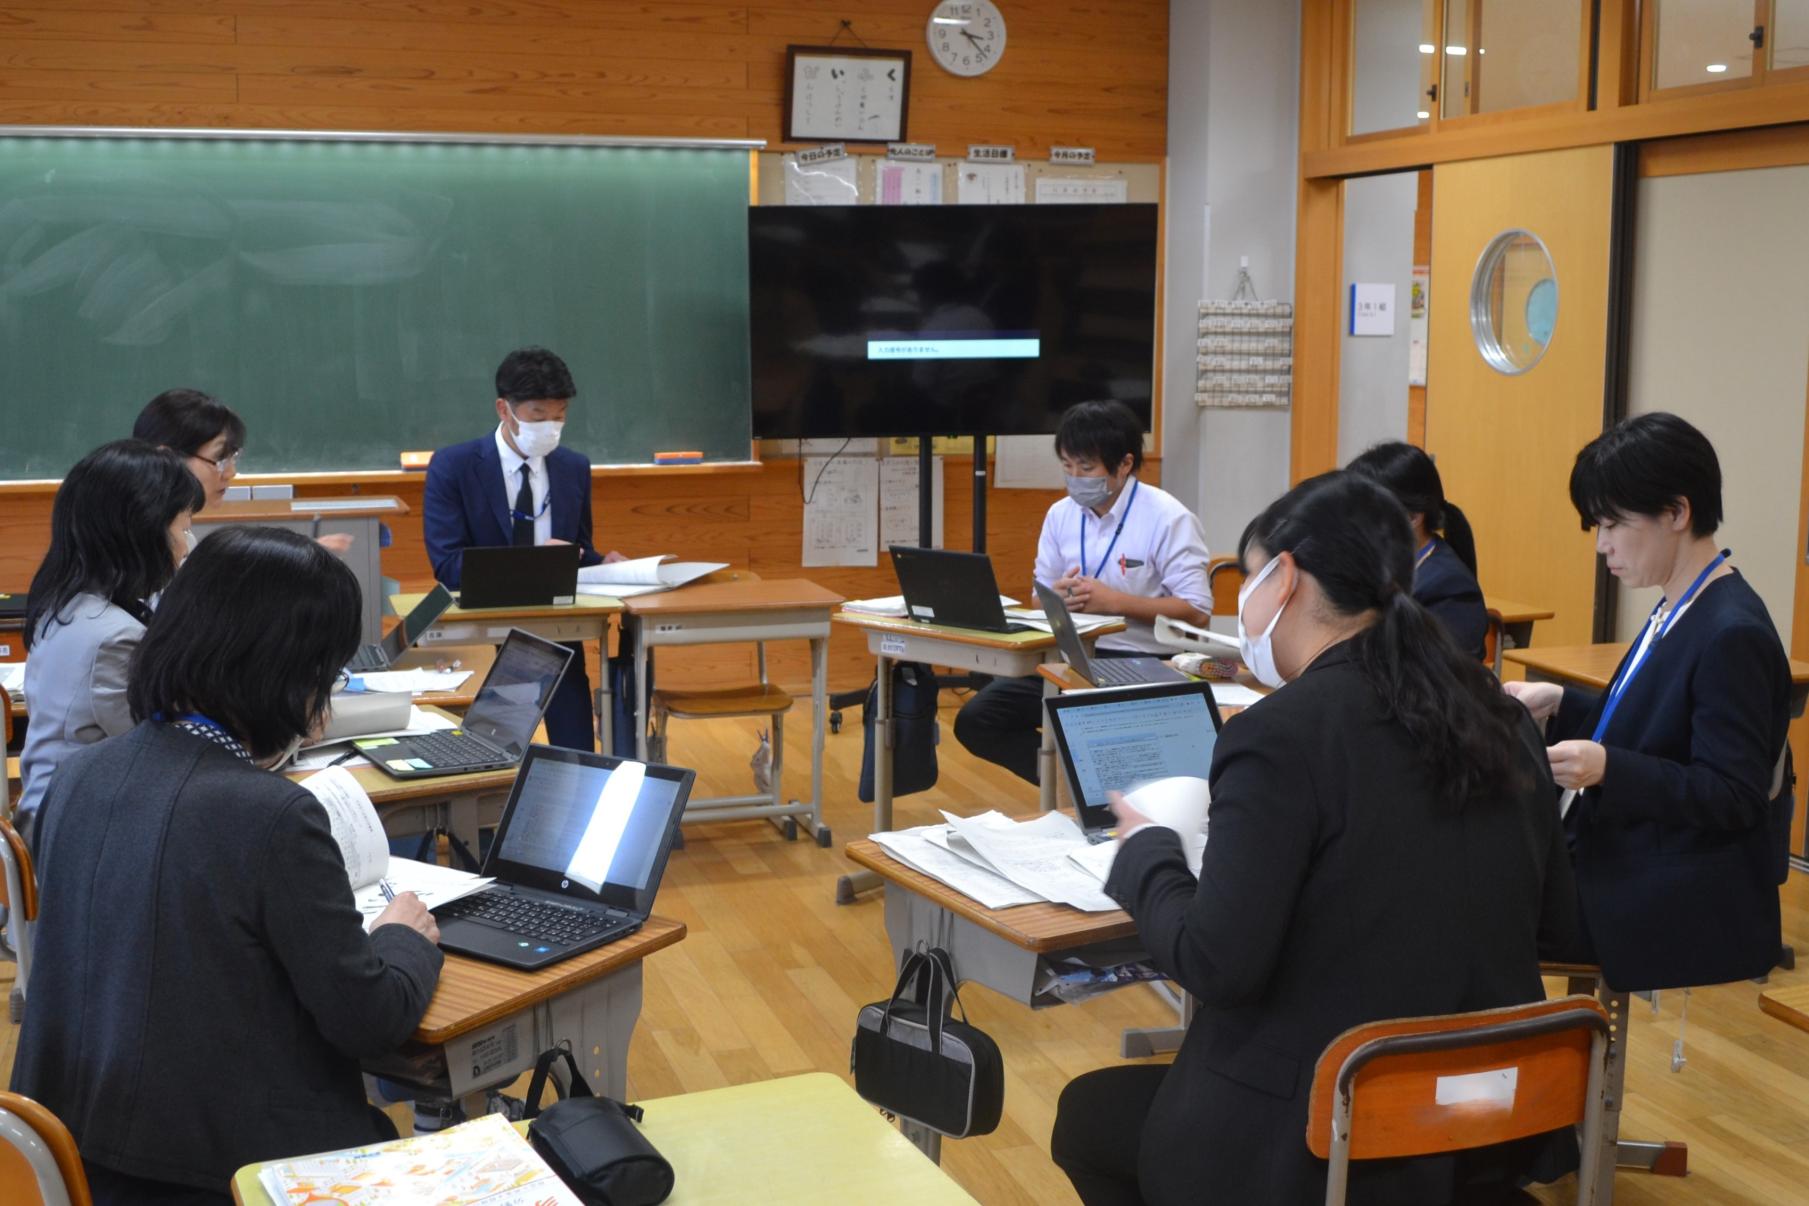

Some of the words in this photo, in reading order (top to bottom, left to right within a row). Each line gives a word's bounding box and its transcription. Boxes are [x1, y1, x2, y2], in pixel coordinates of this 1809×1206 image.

[983, 18, 991, 27] 2
[938, 29, 946, 39] 9
[987, 31, 994, 41] 3
[942, 42, 950, 52] 8
[951, 52, 958, 62] 7
[962, 56, 970, 66] 6
[975, 53, 983, 63] 5
